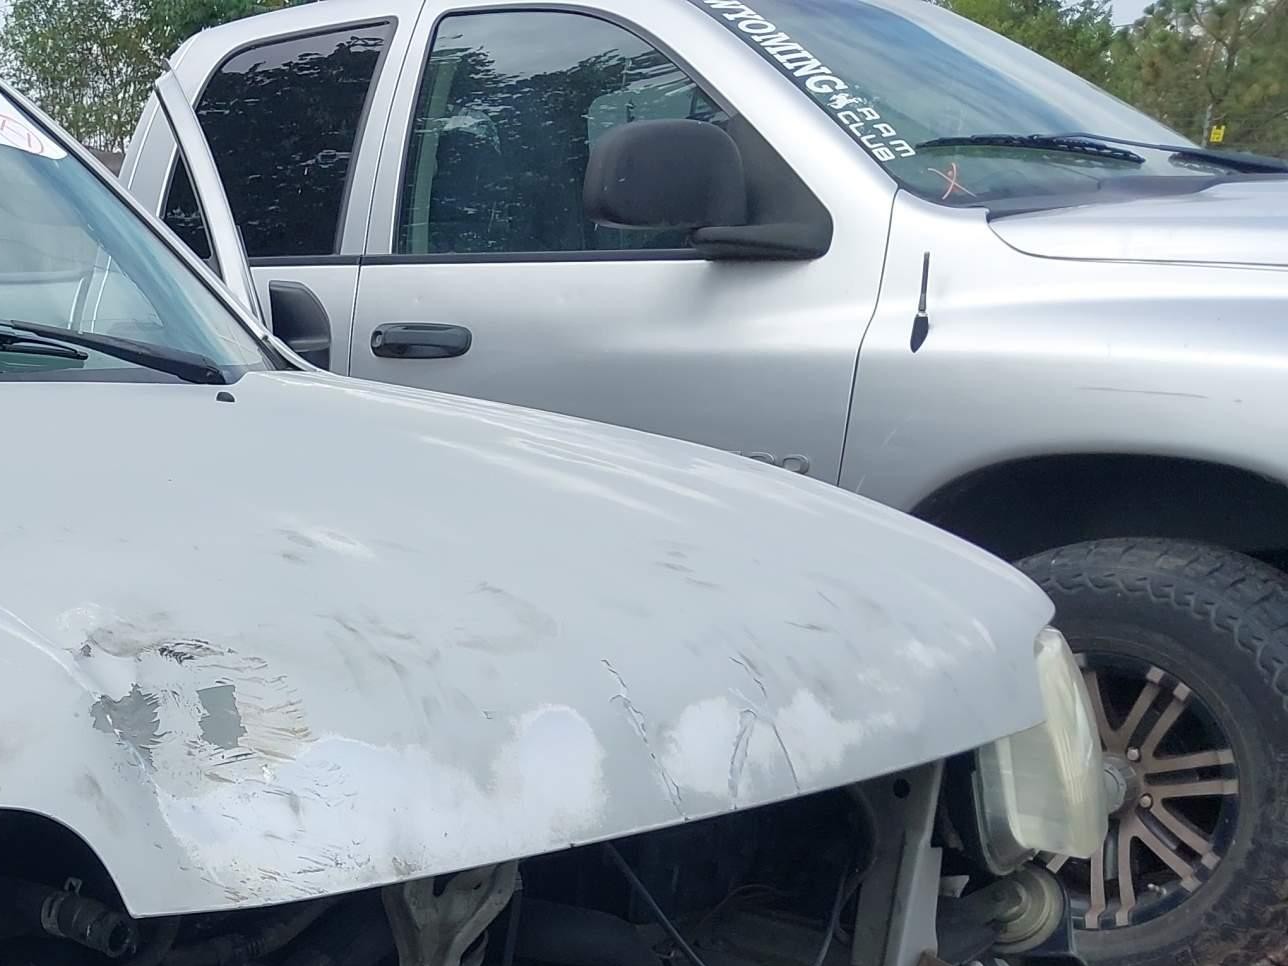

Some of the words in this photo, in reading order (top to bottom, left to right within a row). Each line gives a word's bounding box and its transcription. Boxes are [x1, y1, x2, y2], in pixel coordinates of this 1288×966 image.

[703, 0, 849, 95] WYOMING
[837, 110, 896, 162] CLUB
[857, 107, 916, 158] RAM
